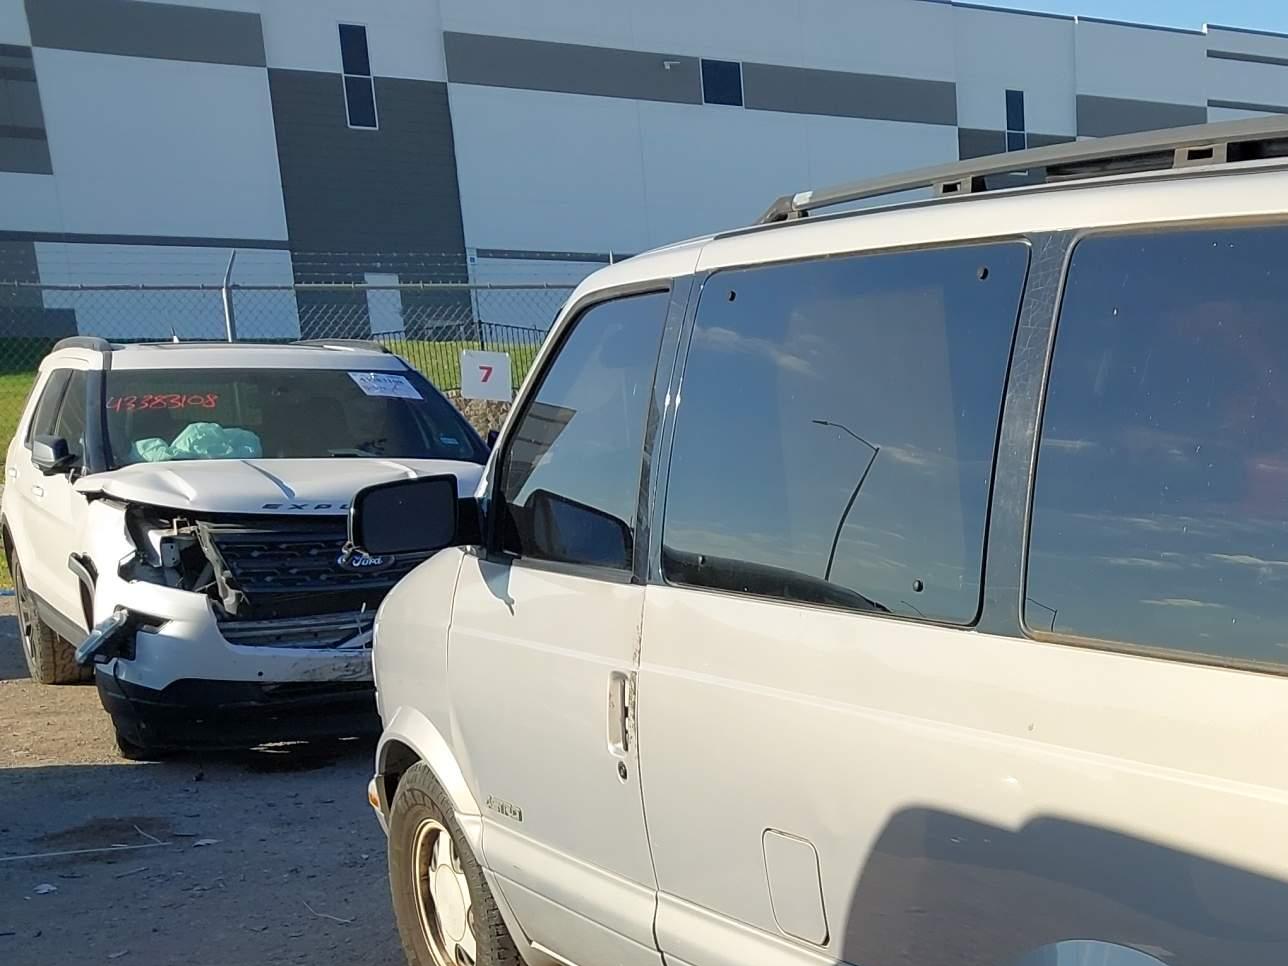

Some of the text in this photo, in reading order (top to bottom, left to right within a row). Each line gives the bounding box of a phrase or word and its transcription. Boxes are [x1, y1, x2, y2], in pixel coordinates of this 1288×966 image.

[479, 364, 494, 383] 7
[105, 393, 218, 412] 43383108
[351, 555, 384, 567] Ford
